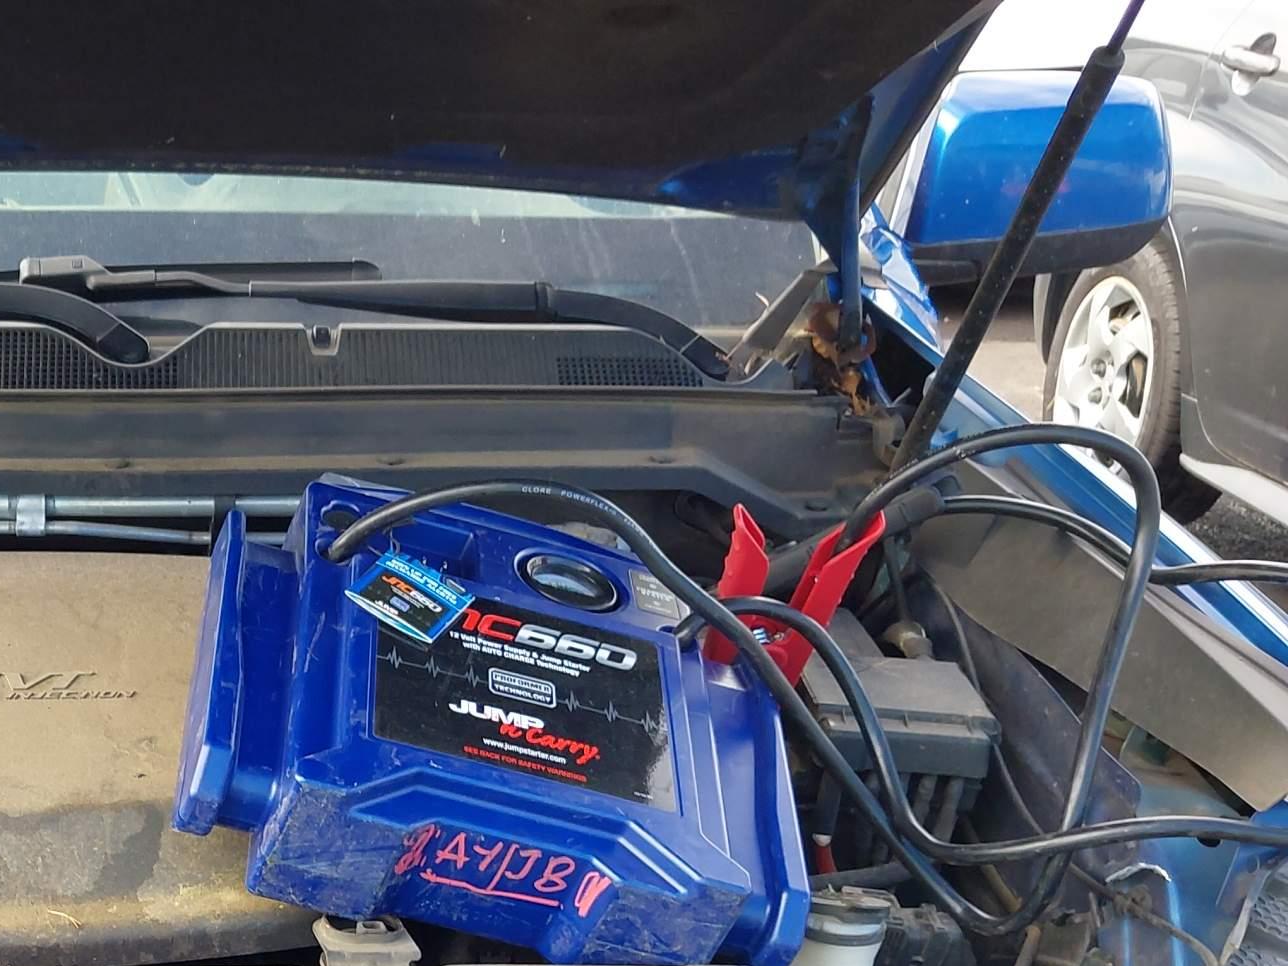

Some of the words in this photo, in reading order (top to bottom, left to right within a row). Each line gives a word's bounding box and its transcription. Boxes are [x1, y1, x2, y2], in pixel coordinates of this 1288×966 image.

[460, 633, 476, 643] Volt
[477, 637, 503, 650] Power
[503, 644, 531, 658] Supply
[540, 653, 562, 665] Jump
[562, 659, 591, 673] Starter
[462, 642, 481, 651] with
[481, 645, 502, 657] AUTO
[536, 659, 580, 677] Technology
[493, 683, 552, 703] TECHNOLOGY
[449, 700, 544, 729] JUMP
[479, 750, 501, 760] BACK
[482, 738, 566, 765] www.jumpstarter.com
